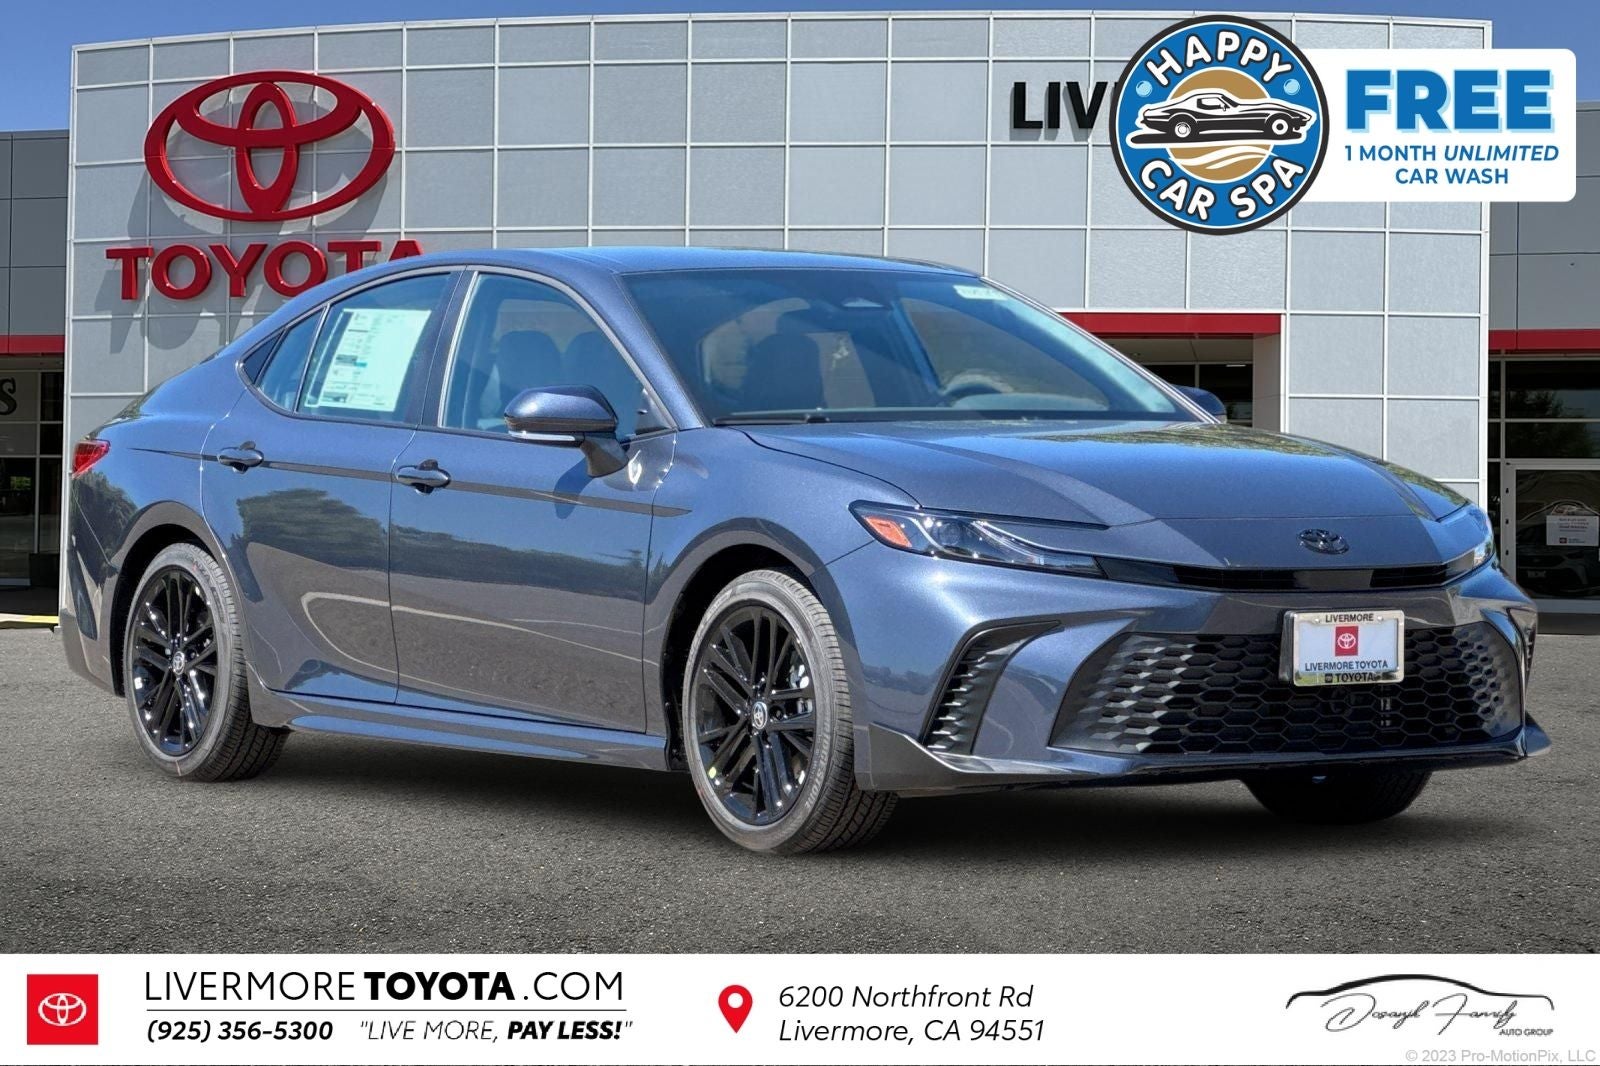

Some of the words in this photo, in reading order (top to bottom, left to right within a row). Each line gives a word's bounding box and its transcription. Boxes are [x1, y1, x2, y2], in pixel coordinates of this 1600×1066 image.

[1013, 81, 1119, 129] LIV
[1325, 613, 1375, 623] LIVERMORE
[1305, 661, 1354, 671] LIVERMORE
[1355, 660, 1388, 669] TOYOTA
[1336, 672, 1375, 682] TOYOTA
